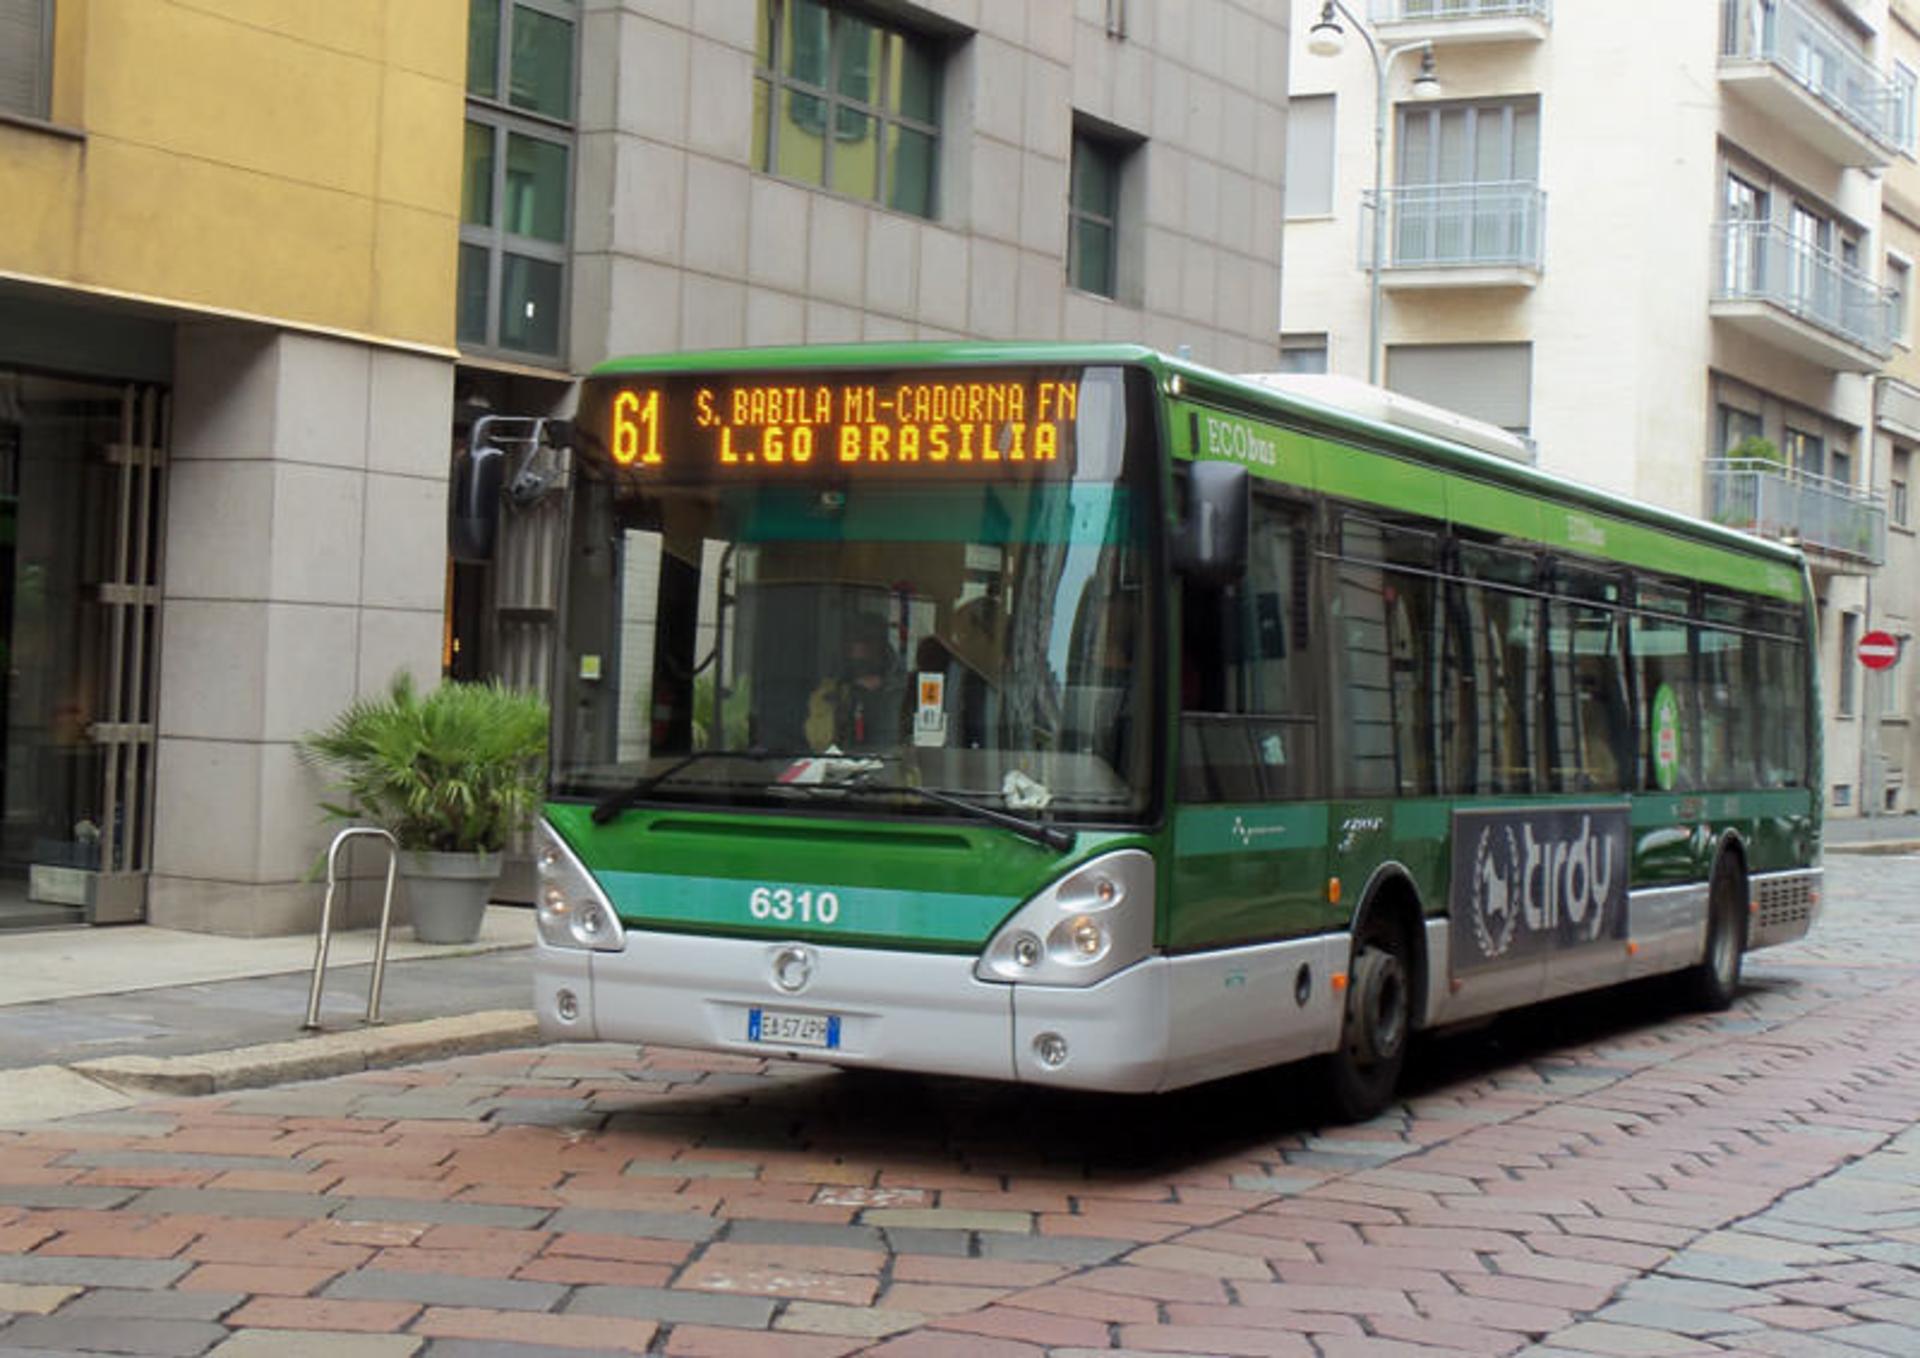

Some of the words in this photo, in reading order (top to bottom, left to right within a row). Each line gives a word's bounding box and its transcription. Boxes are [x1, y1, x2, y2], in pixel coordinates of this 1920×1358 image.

[697, 387, 722, 427] S.
[732, 384, 831, 426] BABILA
[844, 382, 1025, 424] M1-CADORNA
[1038, 381, 1078, 422] FN
[612, 388, 663, 465] 61
[720, 425, 813, 463] L.GO
[839, 422, 1058, 463] BRASILIA
[750, 886, 840, 925] 6310
